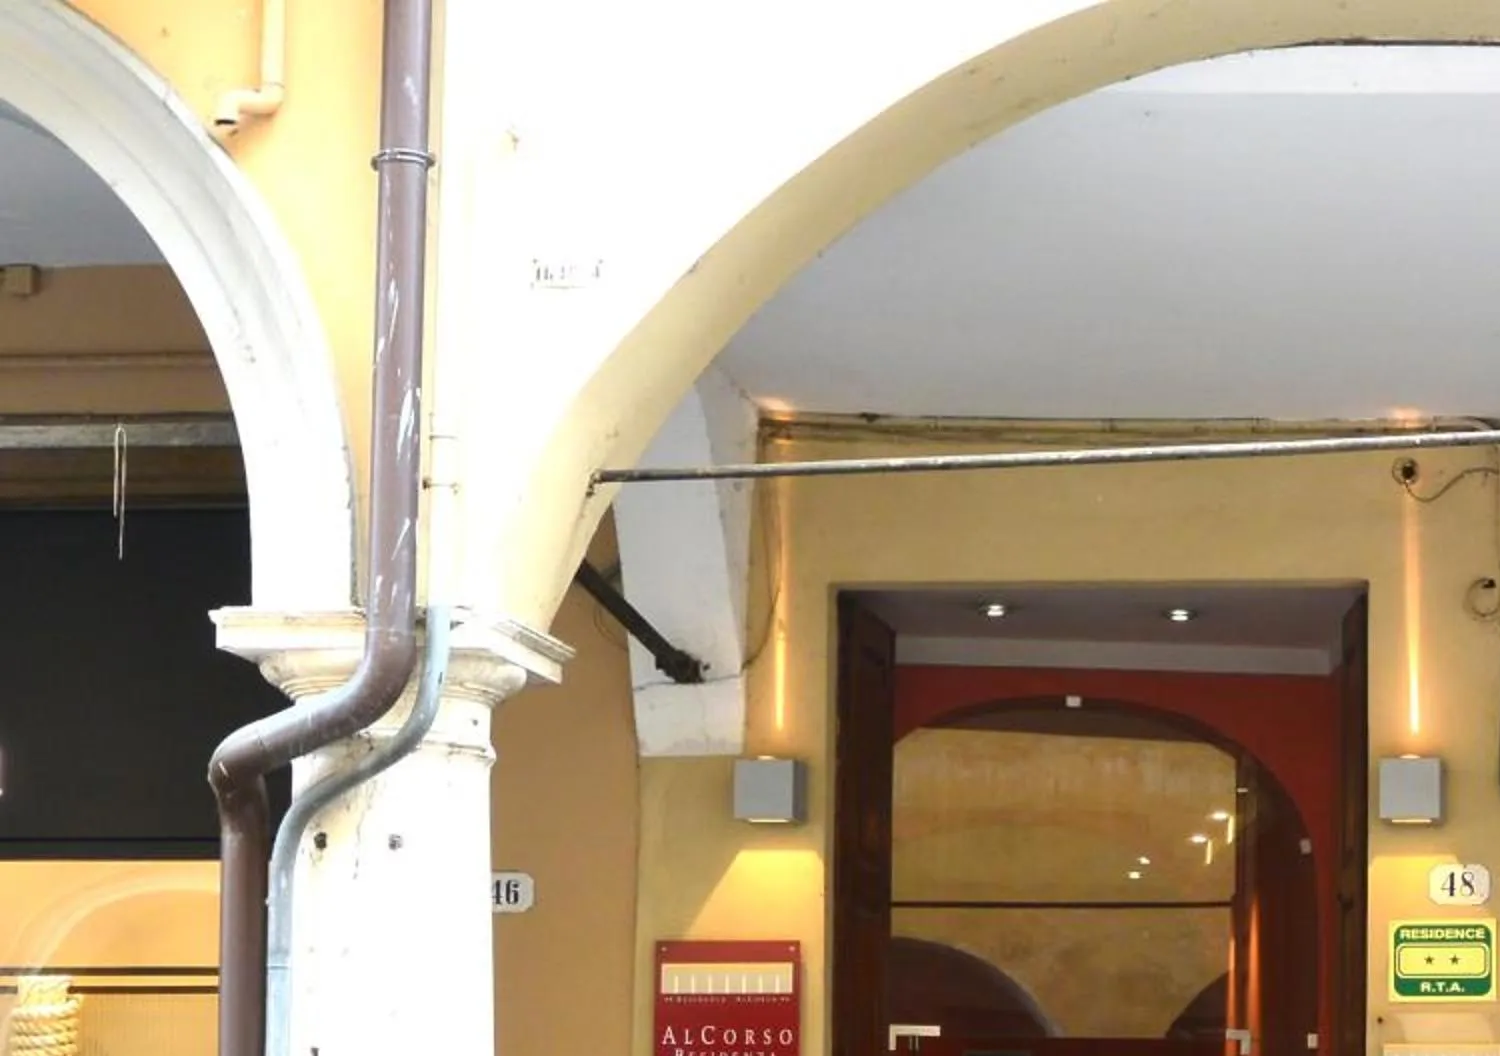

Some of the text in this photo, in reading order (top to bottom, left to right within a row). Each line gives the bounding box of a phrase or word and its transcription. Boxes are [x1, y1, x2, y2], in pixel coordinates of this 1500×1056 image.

[491, 879, 520, 905] 46
[1440, 871, 1475, 898] 48
[1399, 927, 1486, 940] RESIDENCE
[1420, 981, 1466, 993] R.T.A.
